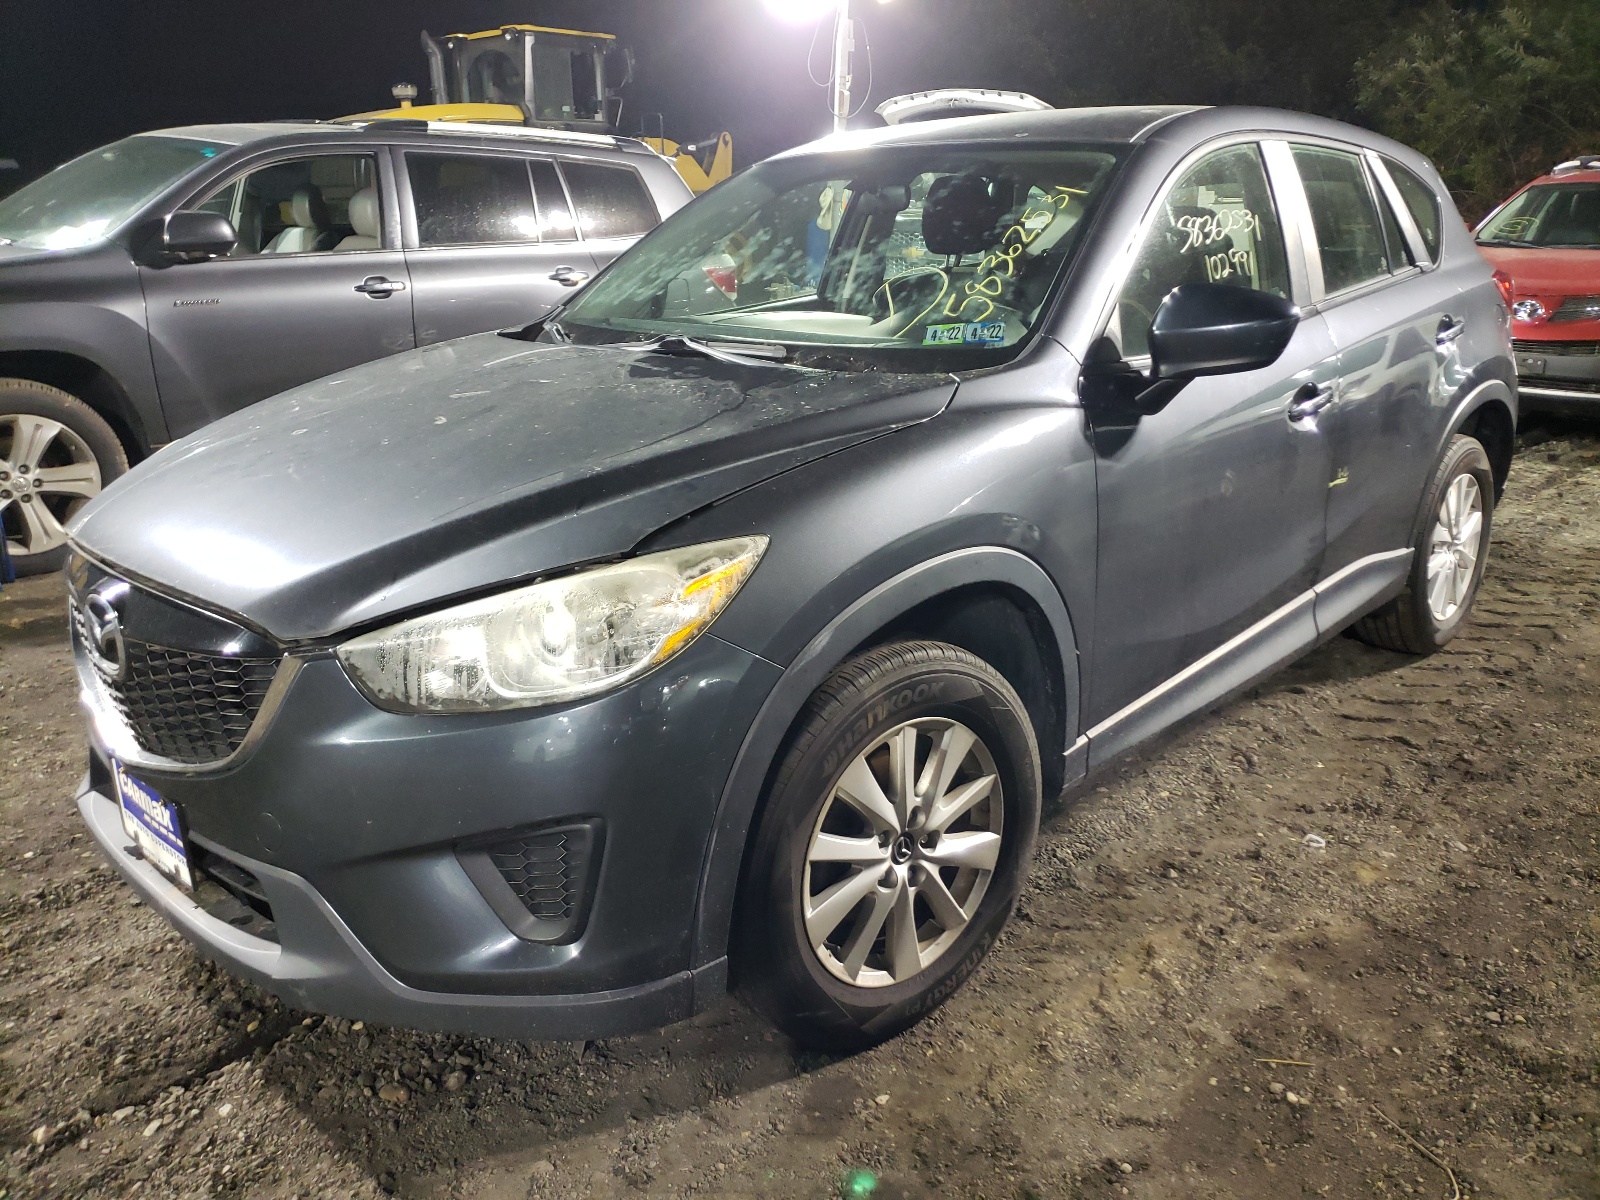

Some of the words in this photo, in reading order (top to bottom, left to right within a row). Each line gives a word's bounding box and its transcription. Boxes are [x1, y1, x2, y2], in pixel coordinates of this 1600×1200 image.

[930, 329, 938, 341] 4
[948, 326, 961, 340] 22
[970, 327, 978, 340] 4
[989, 324, 1002, 339] 22
